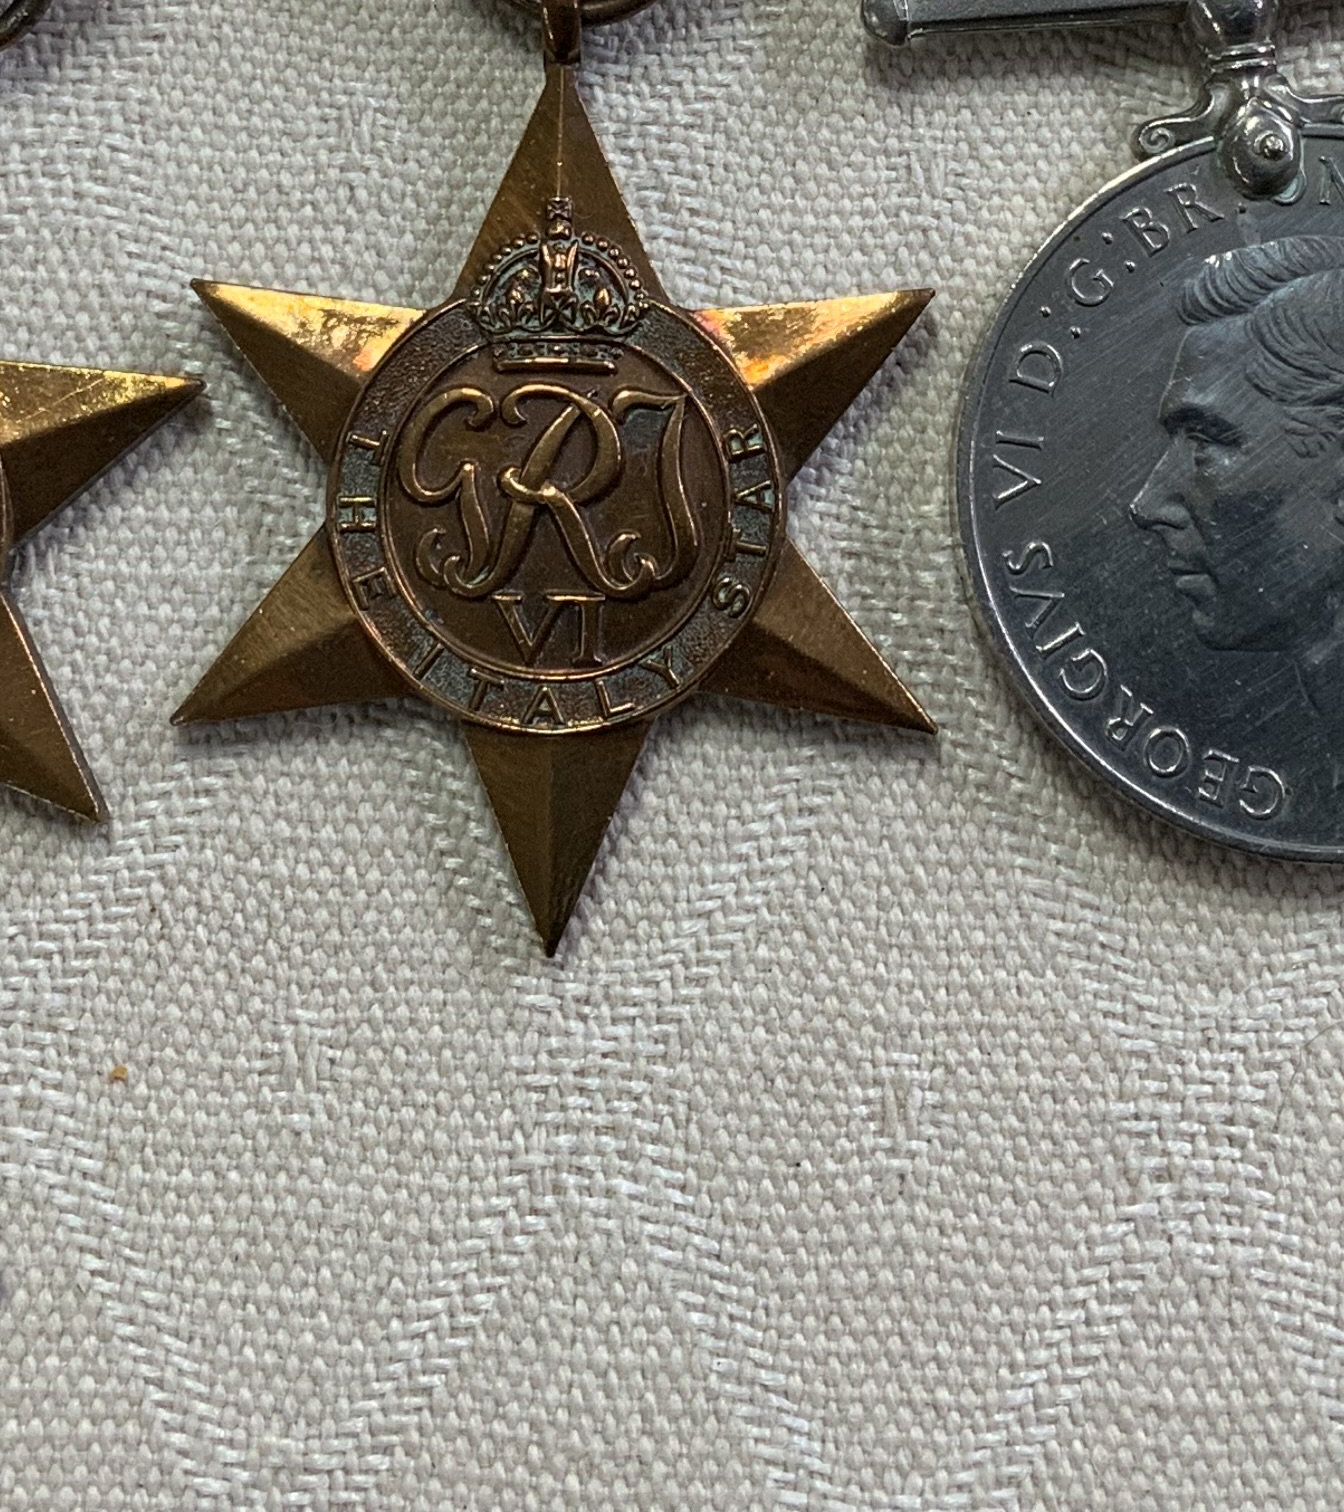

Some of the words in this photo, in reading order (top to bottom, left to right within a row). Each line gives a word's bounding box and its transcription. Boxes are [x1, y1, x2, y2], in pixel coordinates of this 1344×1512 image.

[337, 430, 397, 610] THE
[414, 647, 686, 726] ITALY
[710, 423, 773, 619] STAR
[1002, 541, 1290, 820] GEORGIVS
